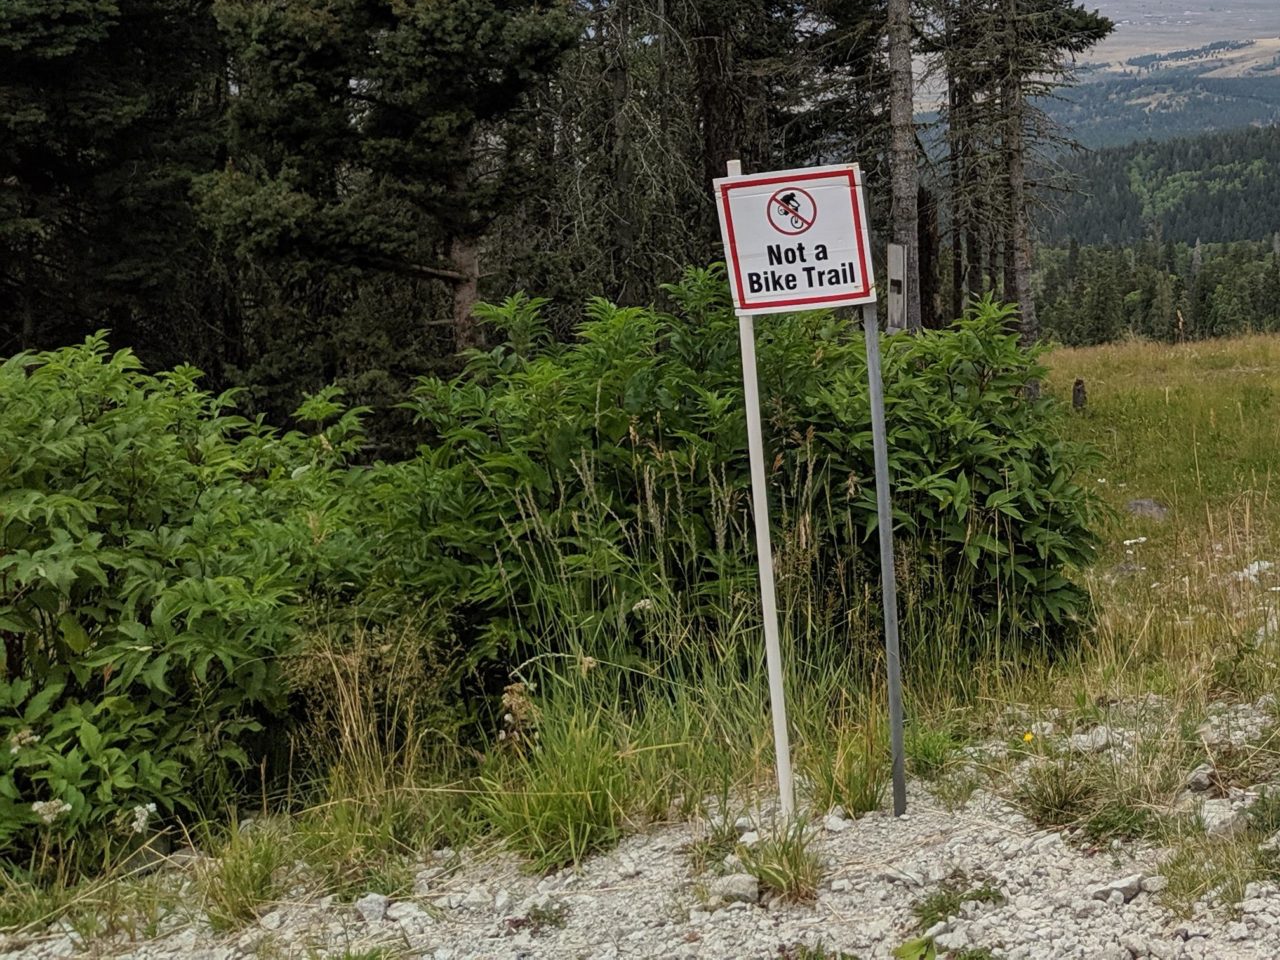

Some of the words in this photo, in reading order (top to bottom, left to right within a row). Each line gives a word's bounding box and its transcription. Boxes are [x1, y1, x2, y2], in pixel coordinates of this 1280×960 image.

[767, 243, 806, 266] Not
[814, 244, 828, 261] a
[748, 270, 797, 294] Bike
[802, 262, 856, 288] Trail
